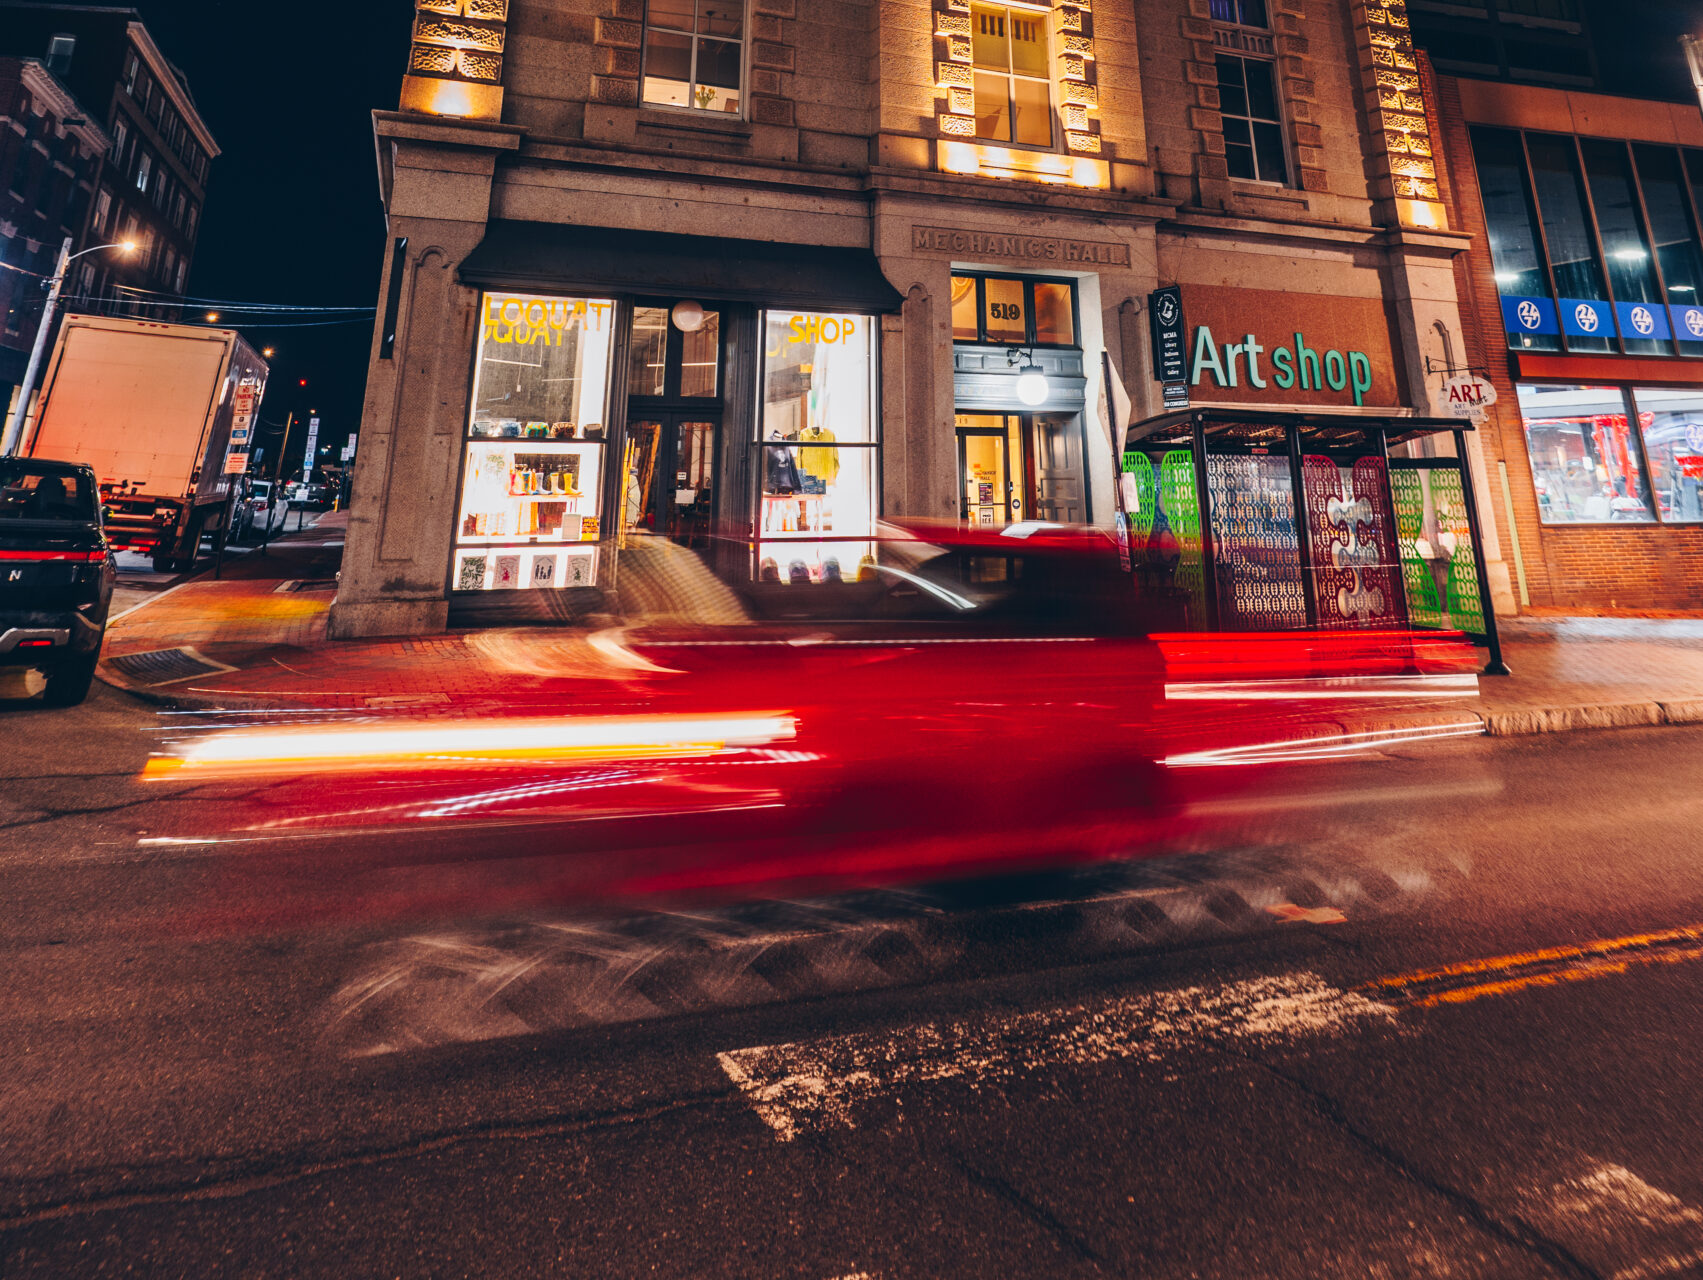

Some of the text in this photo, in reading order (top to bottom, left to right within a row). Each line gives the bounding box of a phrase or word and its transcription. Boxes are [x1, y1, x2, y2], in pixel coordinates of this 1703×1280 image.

[484, 296, 611, 332] LOQUAT
[990, 302, 1020, 320] 519
[788, 315, 855, 345] SHOP
[1191, 325, 1372, 406] Art shop
[1449, 384, 1483, 402] ART
